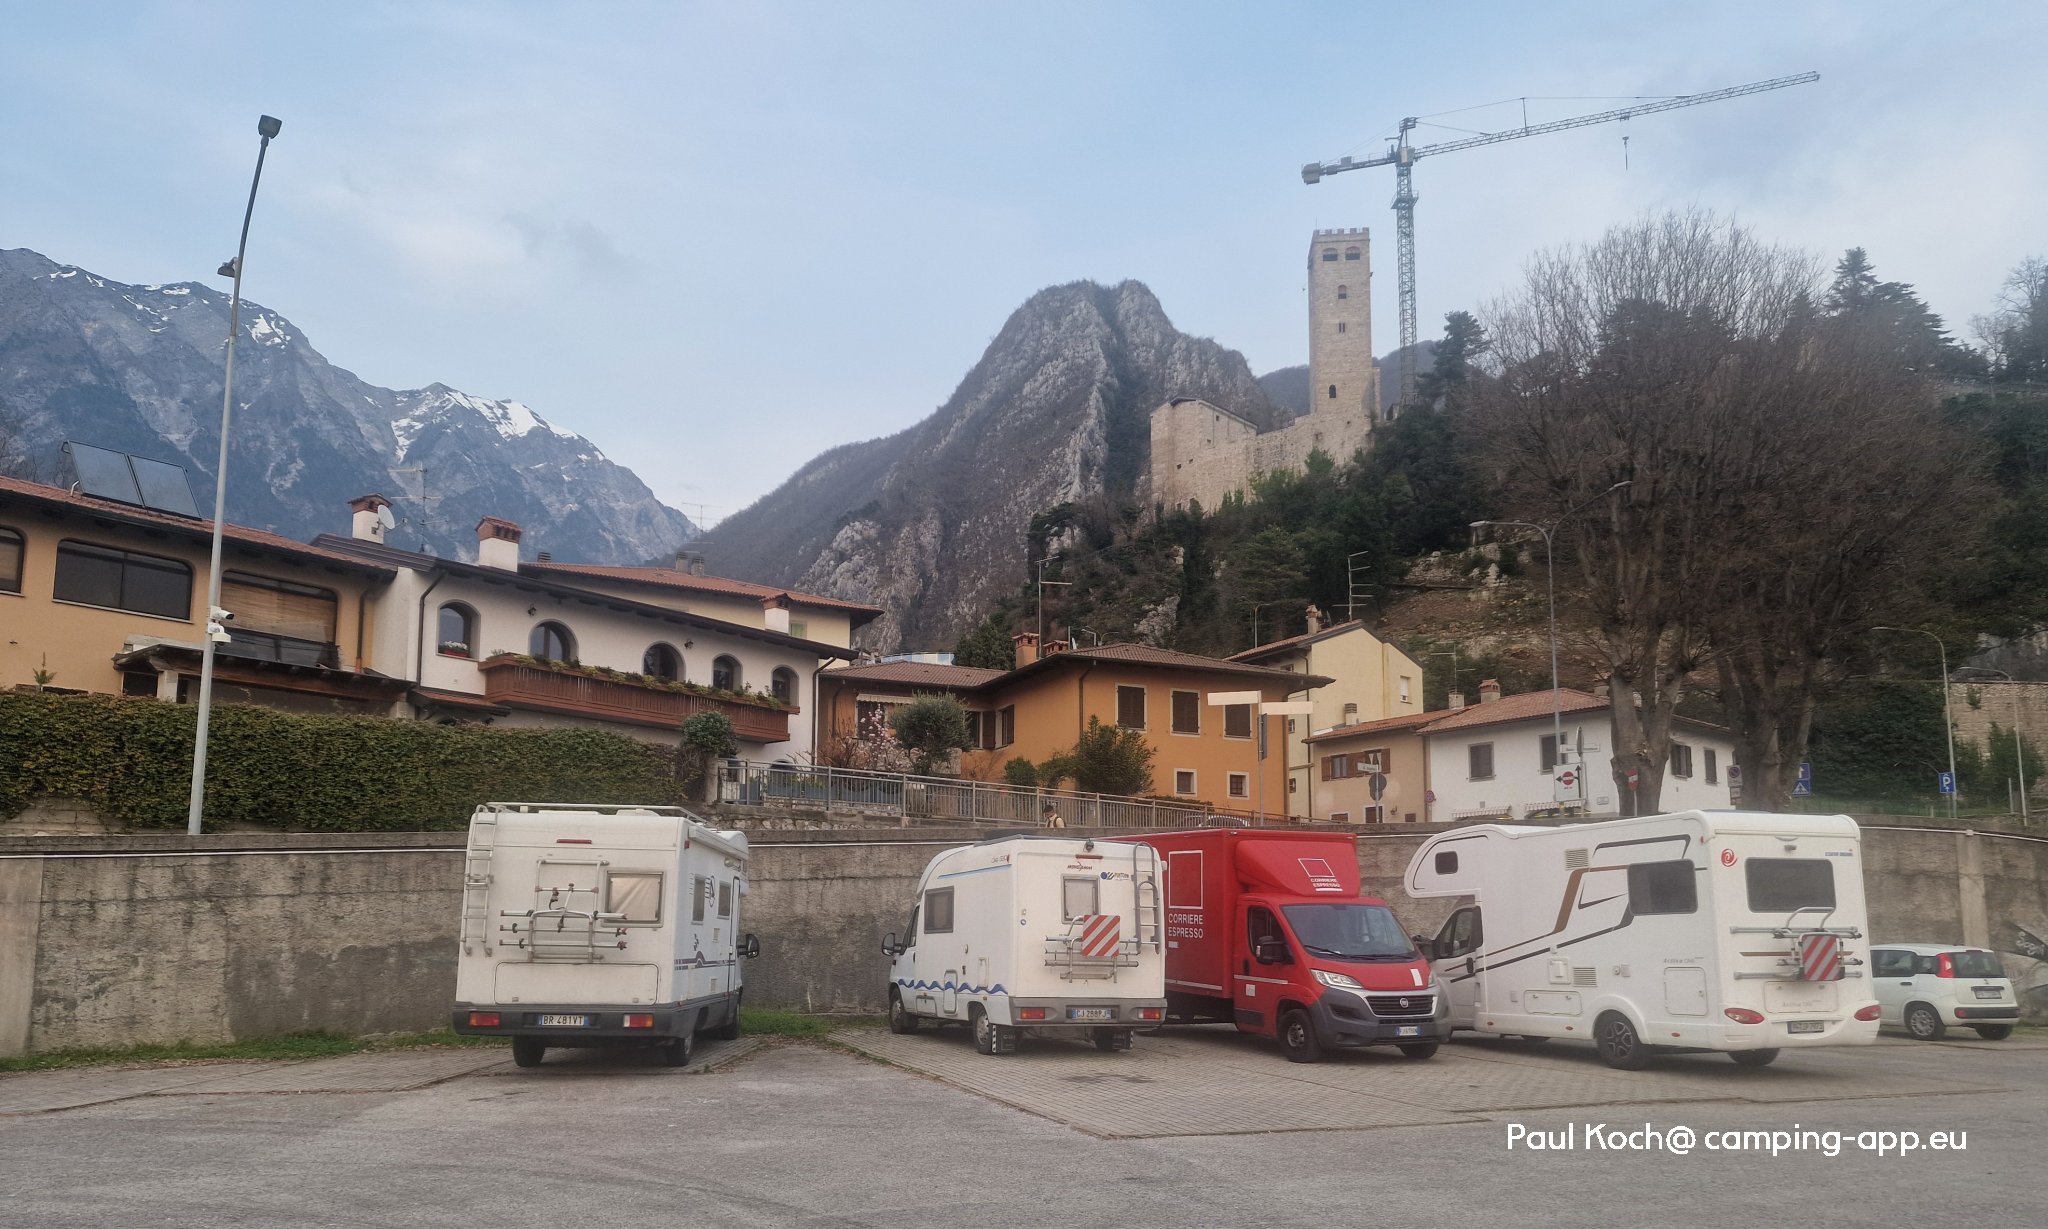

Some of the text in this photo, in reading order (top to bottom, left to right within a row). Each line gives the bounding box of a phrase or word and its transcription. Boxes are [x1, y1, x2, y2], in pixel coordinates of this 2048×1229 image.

[1168, 913, 1204, 925] CORRIERE
[1168, 926, 1204, 939] ESPRESSO
[543, 1015, 583, 1025] BR 481VT
